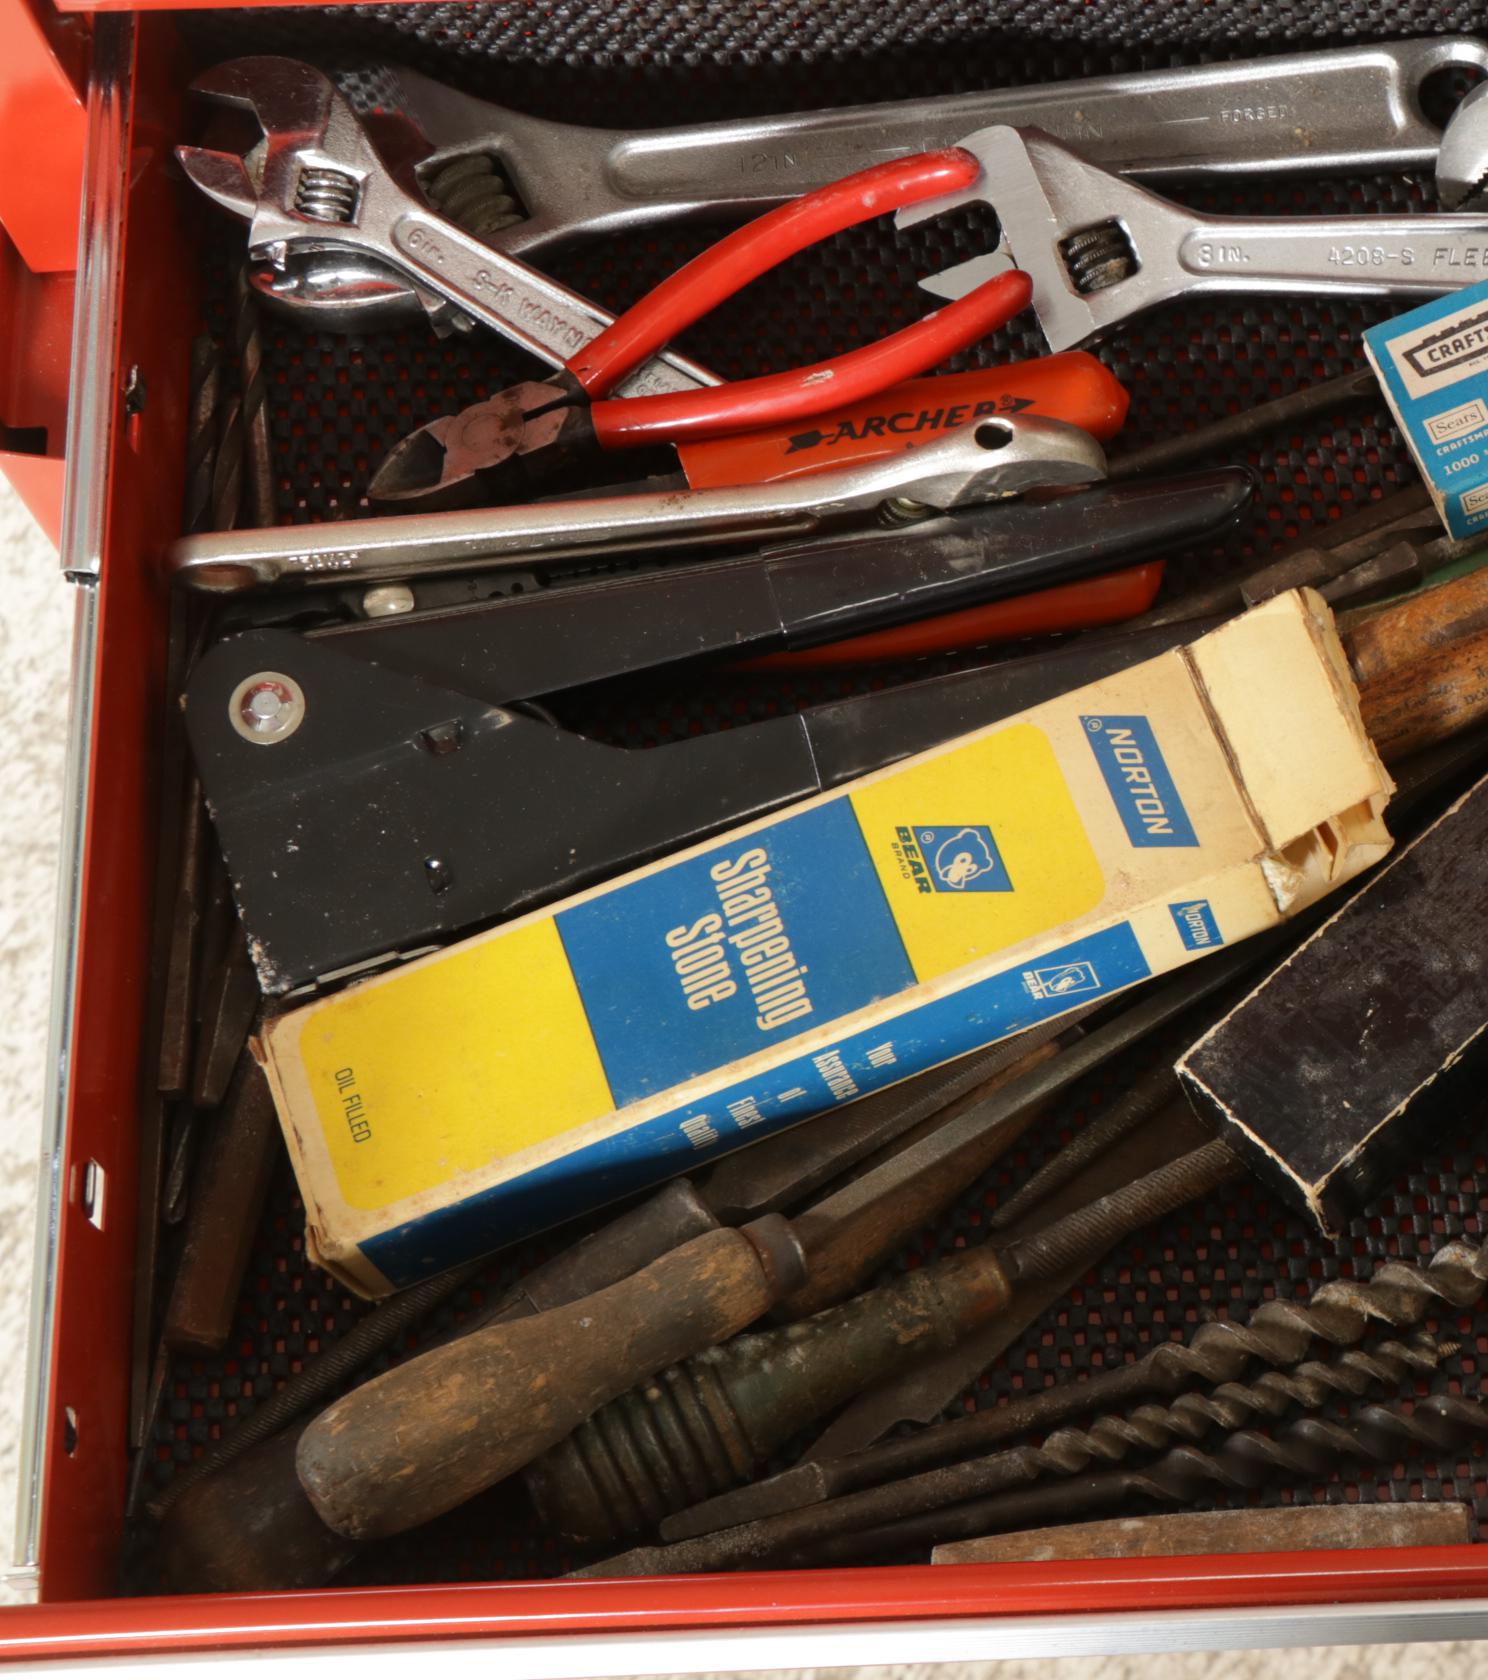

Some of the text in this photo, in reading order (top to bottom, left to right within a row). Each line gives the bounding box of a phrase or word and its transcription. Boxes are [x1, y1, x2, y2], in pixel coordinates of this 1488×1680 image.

[826, 400, 996, 445] ARCHER
[1435, 410, 1478, 434] Sears
[1443, 453, 1480, 476] 1000
[1104, 728, 1174, 834] NORTON
[891, 842, 911, 880] BRAND
[895, 826, 932, 894] BEAR
[710, 847, 814, 1031] Sharpening
[665, 913, 737, 1011] Stone
[812, 1049, 859, 1100] Assurance
[865, 1041, 897, 1068] Your
[335, 1067, 372, 1143] OIL FILLED
[726, 1096, 767, 1130] Finest
[777, 1086, 807, 1103] of
[679, 1113, 720, 1150] Quality
